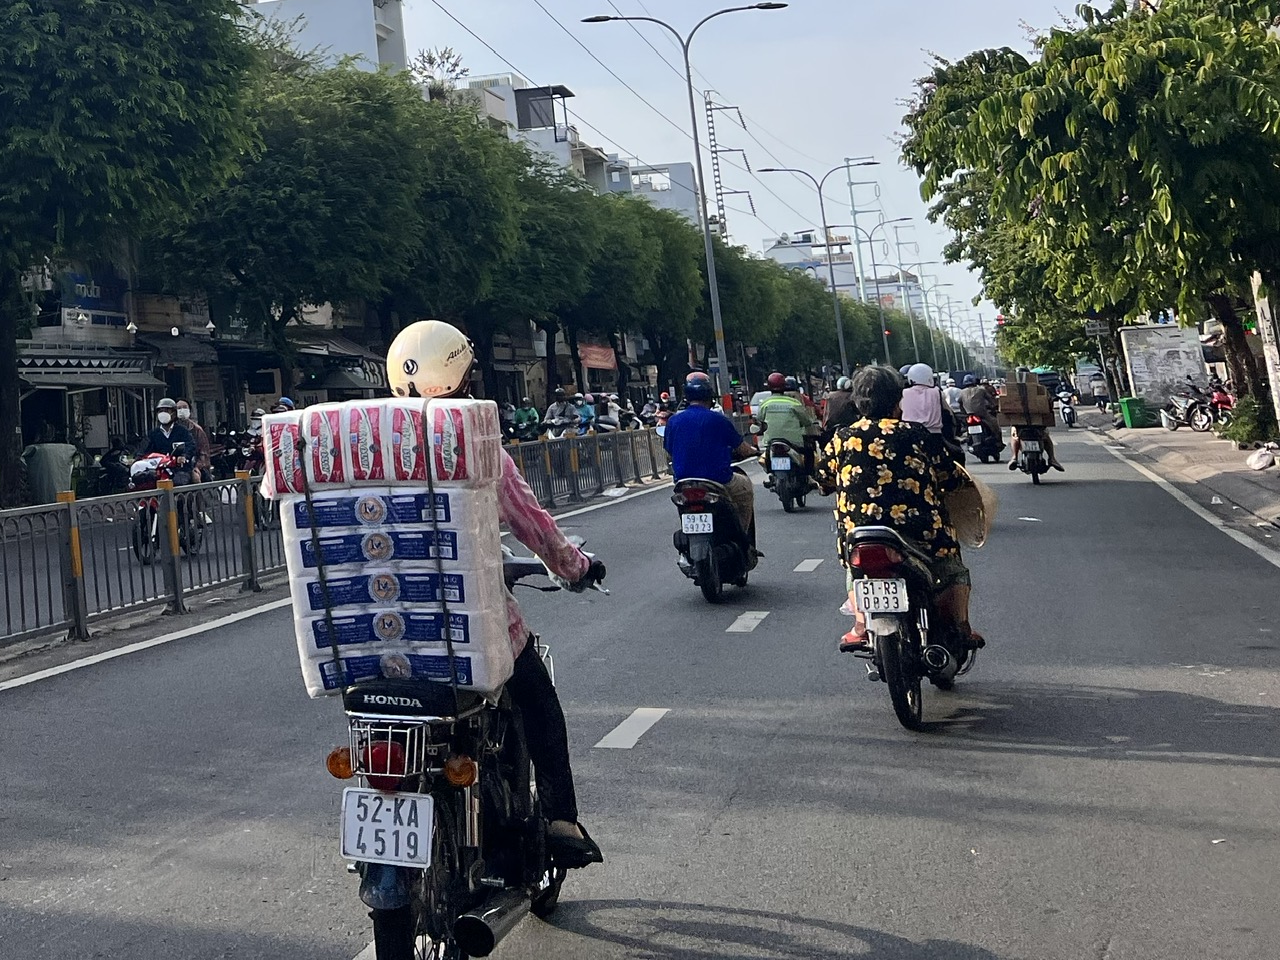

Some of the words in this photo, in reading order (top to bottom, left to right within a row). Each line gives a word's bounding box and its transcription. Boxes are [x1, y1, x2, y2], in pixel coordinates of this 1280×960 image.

[862, 581, 898, 595] 51-R3
[863, 596, 900, 610] 0833
[363, 694, 423, 708] HONDA
[356, 794, 419, 828] 52-KA
[356, 826, 418, 860] 4519
